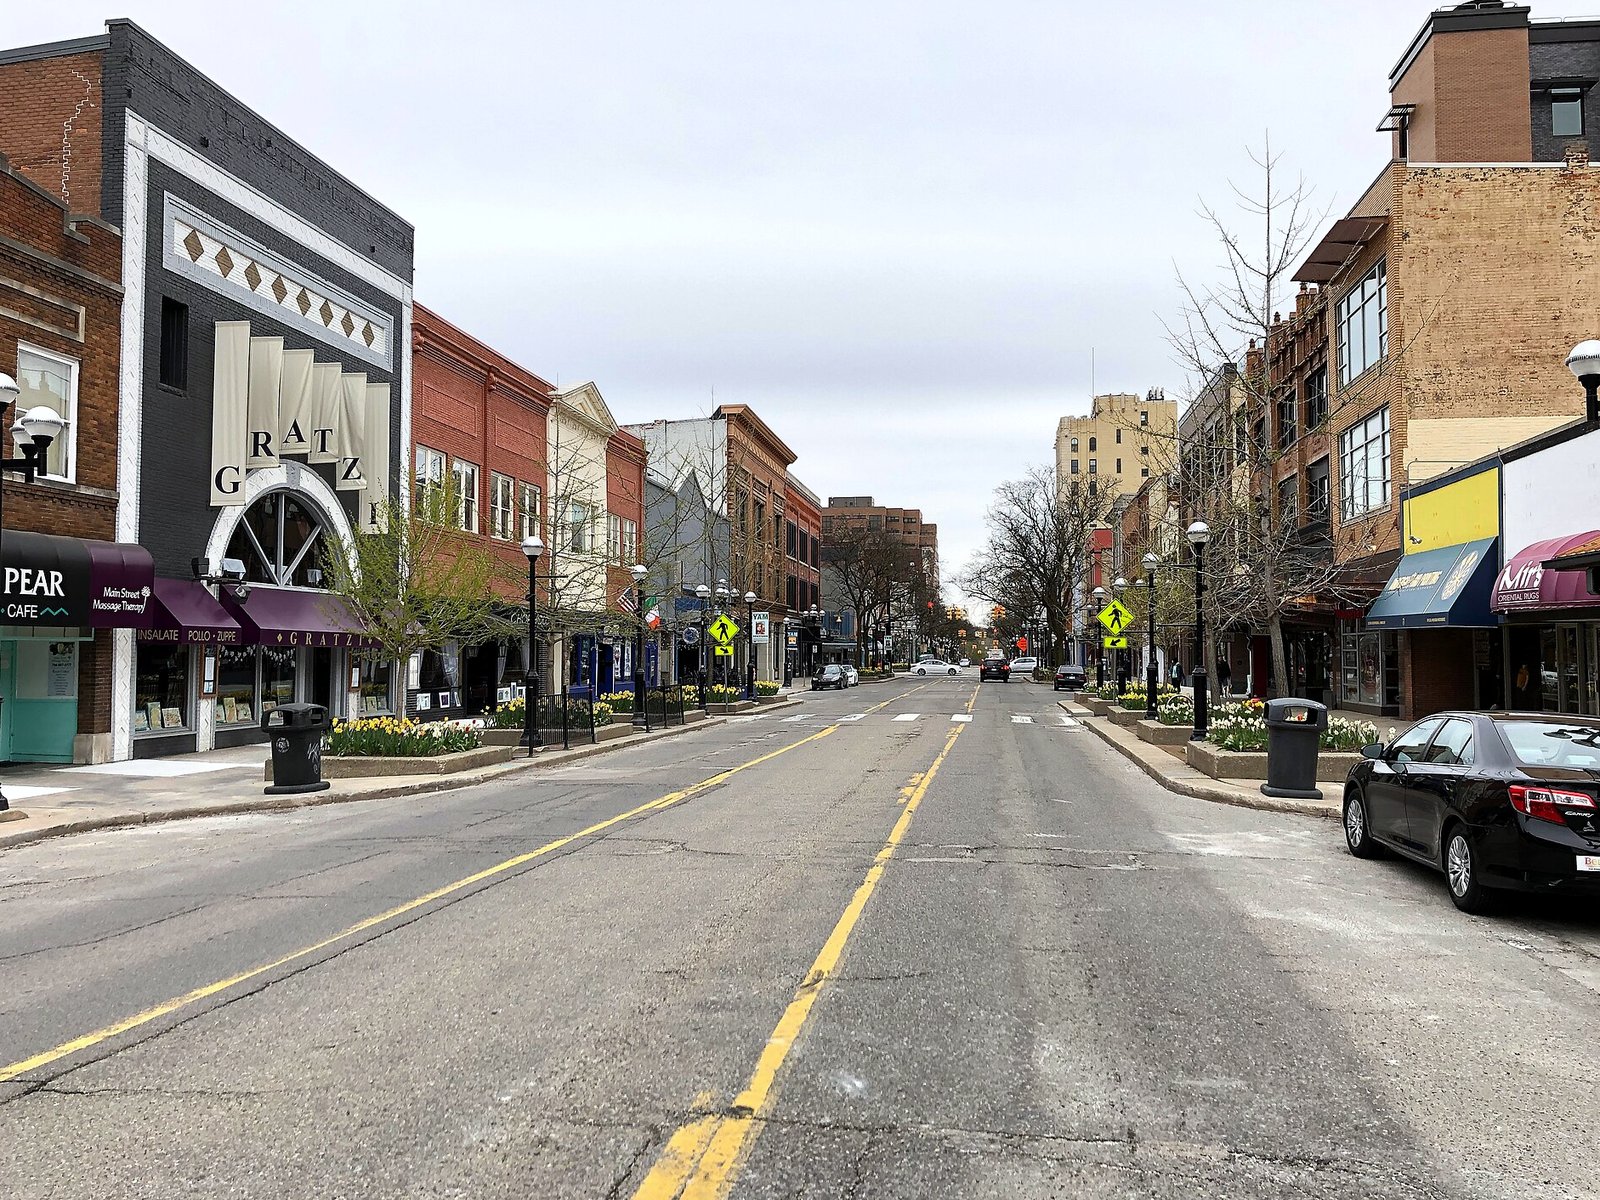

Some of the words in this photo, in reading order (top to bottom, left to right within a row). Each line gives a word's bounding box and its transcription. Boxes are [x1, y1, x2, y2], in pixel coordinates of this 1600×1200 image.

[215, 418, 379, 525] GRATZI
[3, 567, 65, 597] PEAR
[103, 586, 121, 598] Main
[121, 588, 140, 599] Street
[1497, 593, 1523, 602] ORIENTAL
[1523, 592, 1540, 600] RUGS
[7, 604, 38, 619] CAFE
[93, 599, 121, 612] Massage
[122, 601, 145, 614] Therapy
[138, 629, 179, 641] INSALATE
[188, 630, 211, 642] POLLO
[216, 630, 236, 642] ZUPPE
[289, 631, 363, 646] GRATZI
